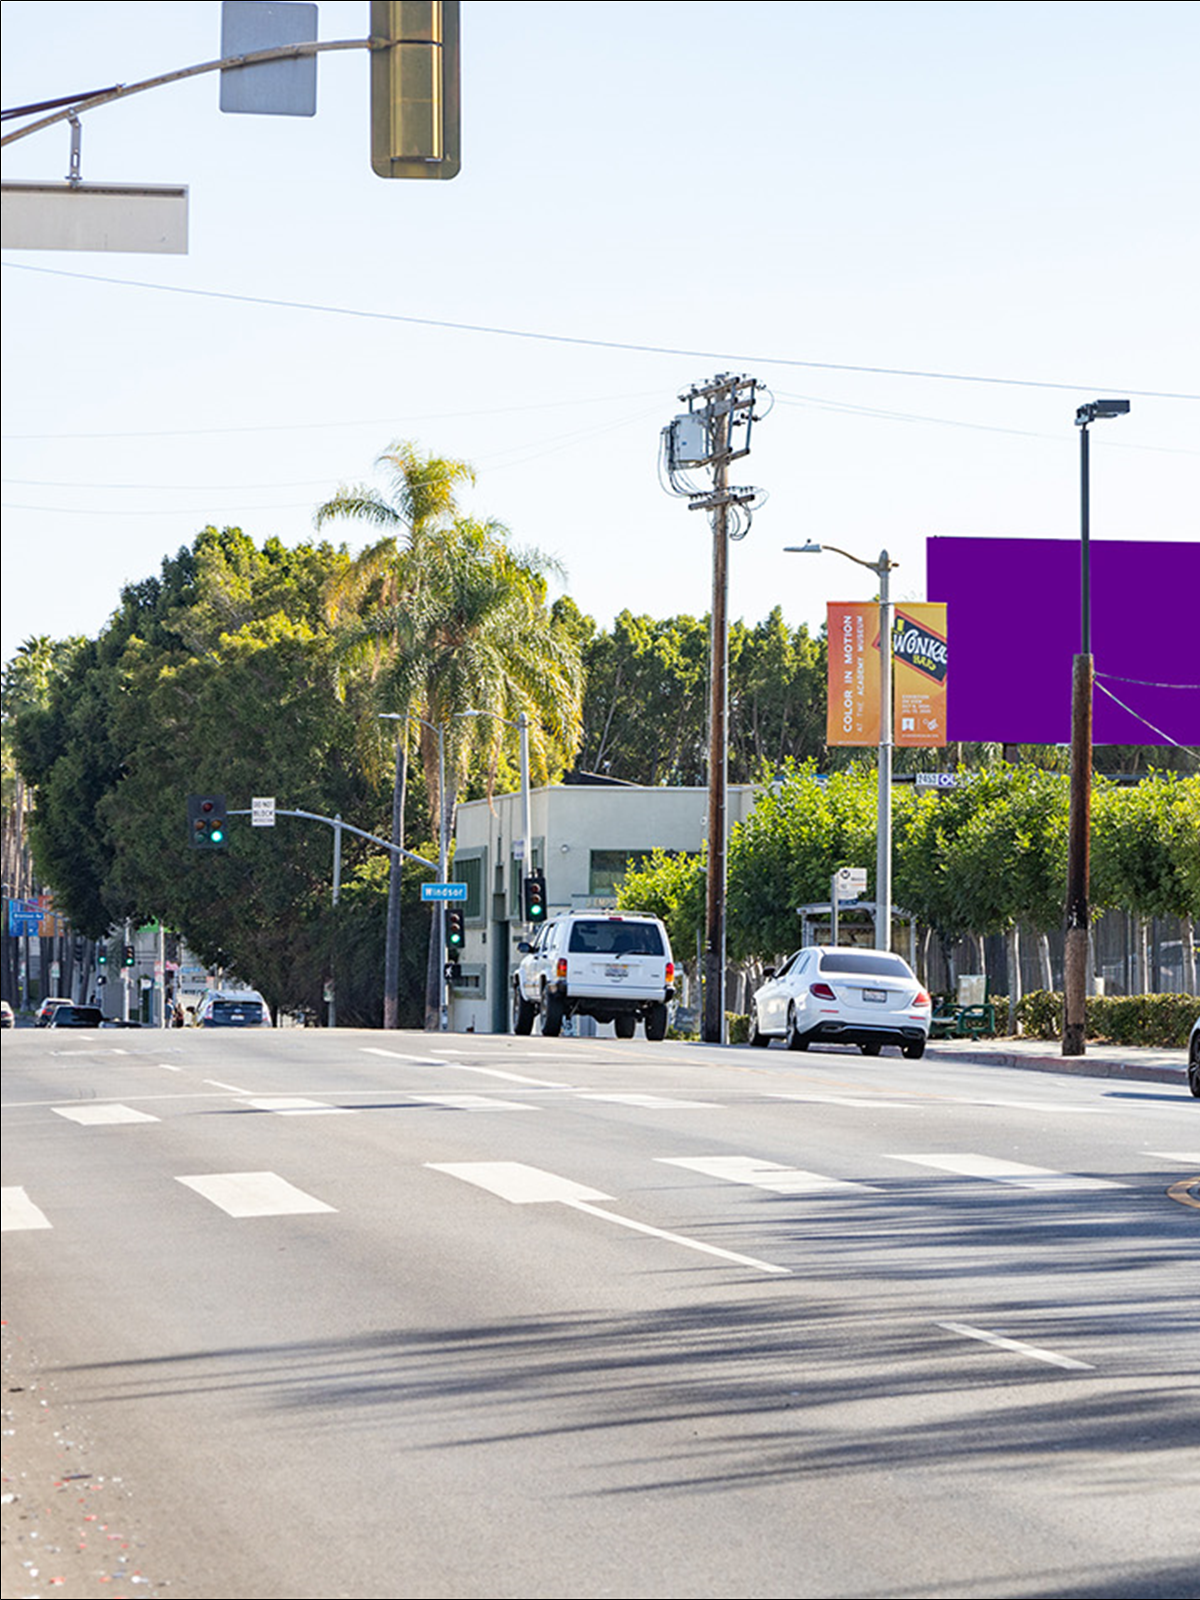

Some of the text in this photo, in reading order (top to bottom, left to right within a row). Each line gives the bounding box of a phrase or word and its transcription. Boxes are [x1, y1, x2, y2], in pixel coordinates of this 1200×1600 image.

[843, 615, 853, 733] COLOR IN MOTION
[425, 887, 464, 897] Windsor
